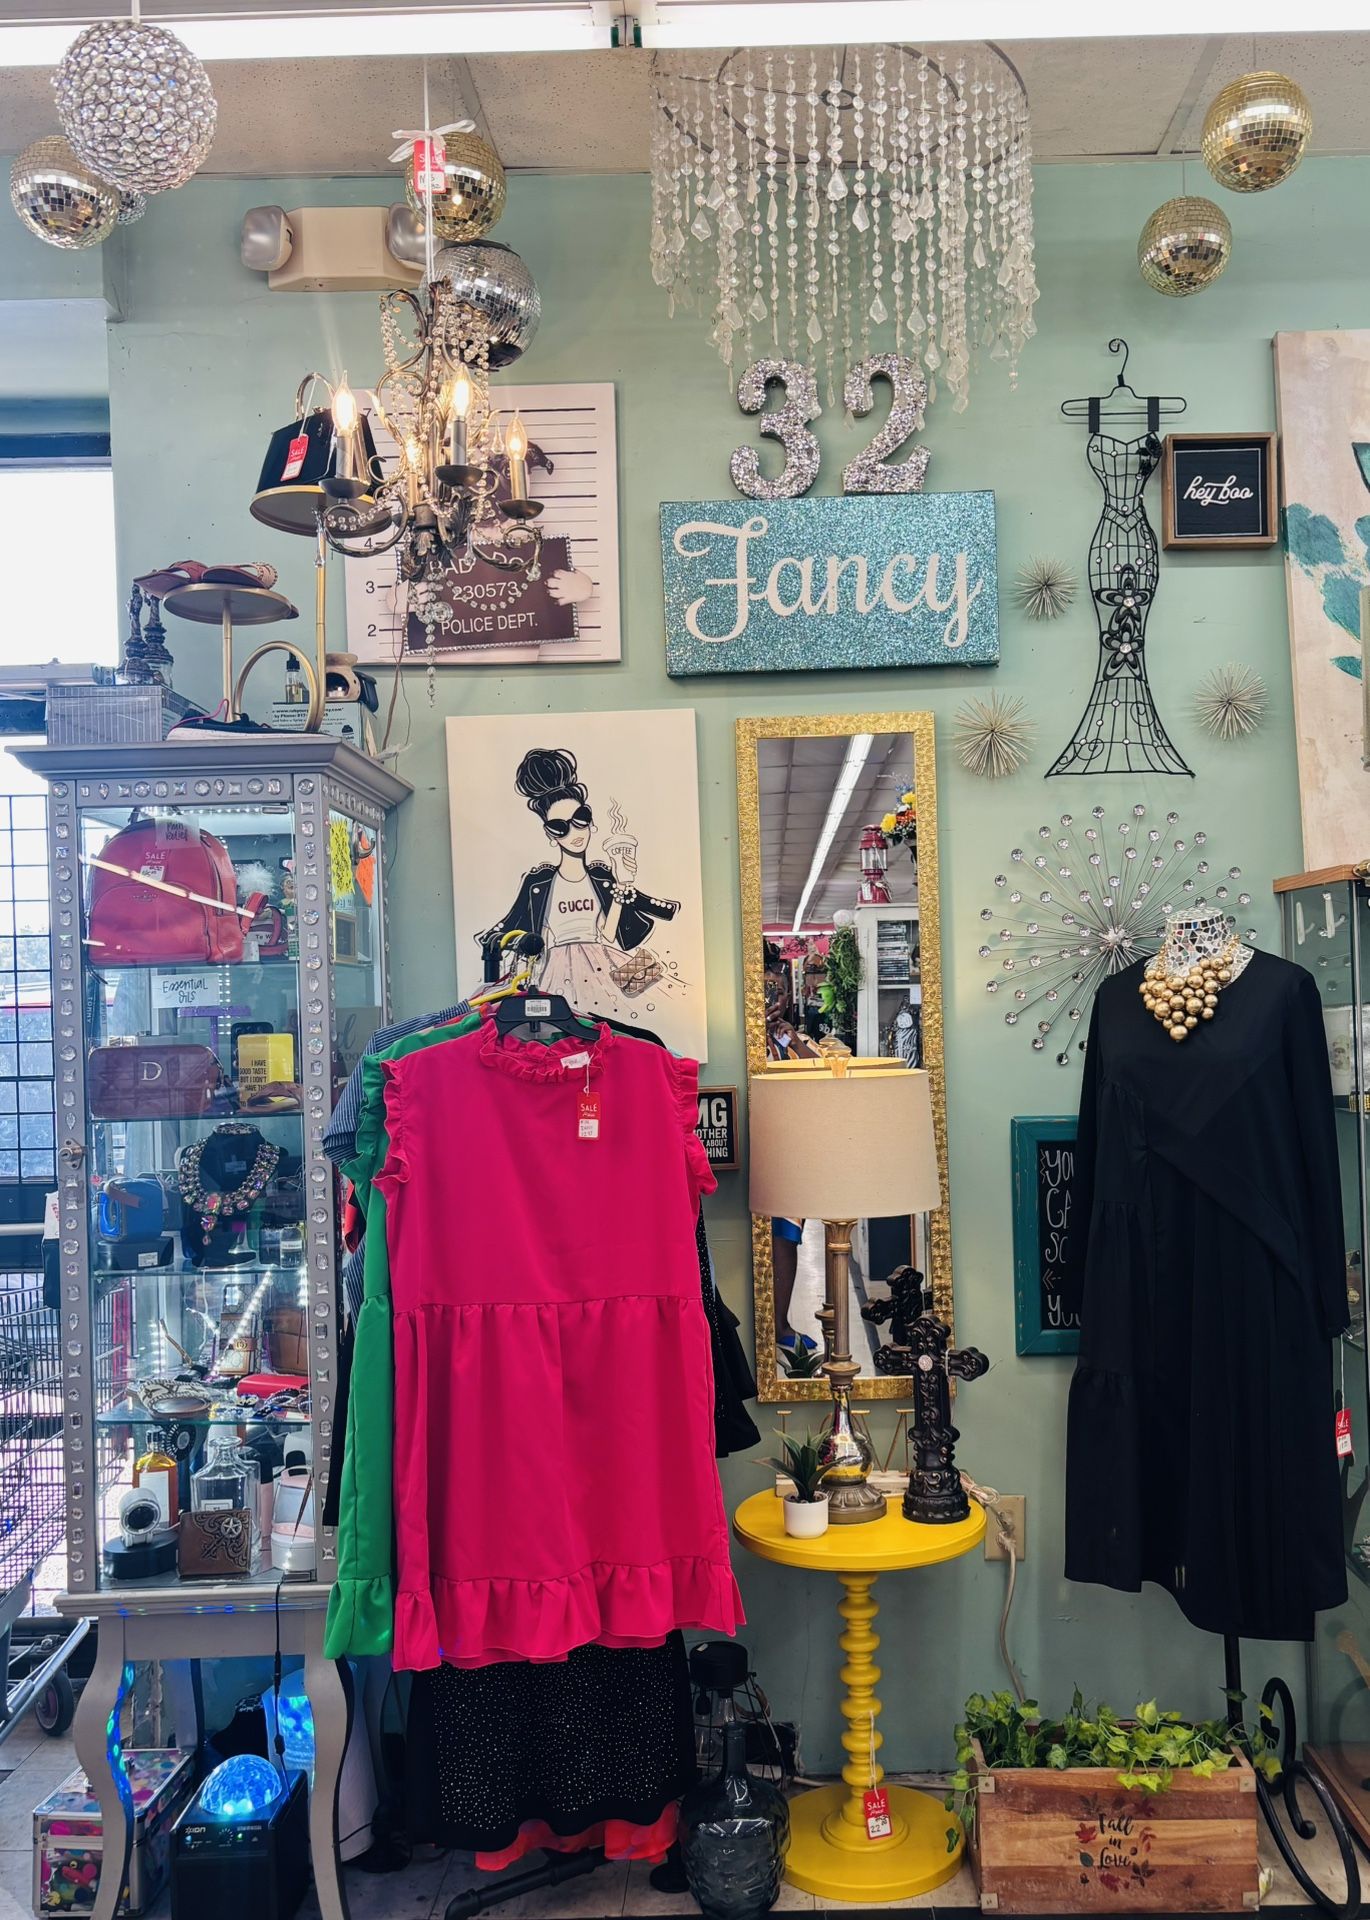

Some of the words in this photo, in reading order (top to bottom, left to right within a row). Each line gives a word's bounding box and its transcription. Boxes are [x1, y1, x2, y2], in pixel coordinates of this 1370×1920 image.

[730, 352, 931, 500] 32
[1183, 475, 1224, 506] hey
[1212, 475, 1254, 500] boo
[363, 537, 373, 549] 4
[365, 581, 375, 594] 3
[672, 515, 983, 648] Fancy
[453, 581, 518, 601] 230573
[367, 624, 377, 637] 2
[441, 616, 494, 636] POLICE
[497, 612, 538, 630] DEPT.
[145, 851, 166, 860] SALE
[611, 846, 632, 856] COFFEE
[558, 899, 594, 914] GUCCI
[140, 1061, 163, 1080] D
[252, 1067, 267, 1075] TASTE
[580, 1103, 598, 1112] SALE
[697, 1097, 728, 1128] MG
[694, 1127, 728, 1140] OTHER
[706, 1138, 728, 1147] ABOUT
[706, 1146, 729, 1158] HING
[866, 1798, 886, 1811] SALE
[1098, 1813, 1134, 1836] Fall
[1109, 1835, 1122, 1850] in
[1097, 1846, 1131, 1870] Love
